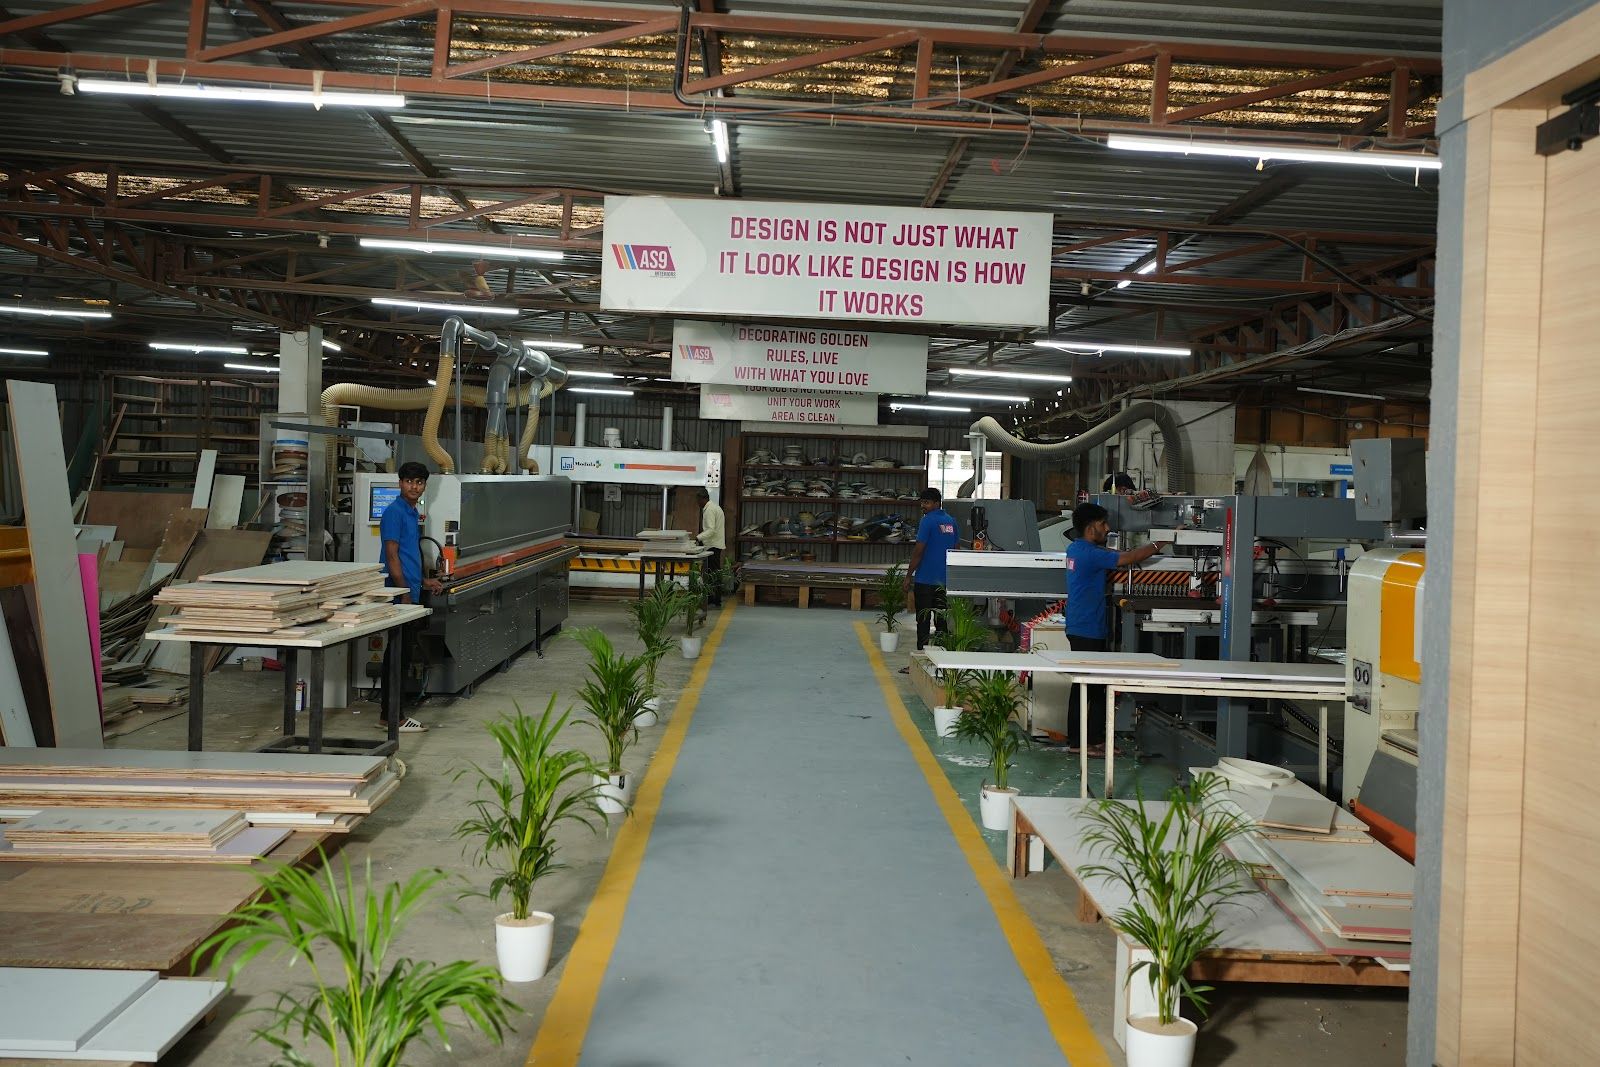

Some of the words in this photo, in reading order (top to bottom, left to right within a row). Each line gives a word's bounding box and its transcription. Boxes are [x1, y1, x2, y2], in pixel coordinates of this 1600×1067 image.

[731, 217, 809, 241] DESIGN
[817, 220, 837, 242] IS
[845, 221, 886, 244] NOT
[892, 225, 948, 247] JUST
[955, 226, 1018, 249] WHAT
[639, 249, 668, 269] AS9
[719, 252, 739, 274] IT
[745, 253, 800, 276] LOOK
[809, 255, 853, 277] LIKE
[862, 257, 939, 281] DESIGN
[947, 261, 967, 283] IS
[975, 262, 1025, 284] HOW
[818, 290, 838, 312] IT
[844, 291, 922, 316] WORKS
[739, 328, 815, 344] DECORATING
[821, 331, 868, 347] GOLDEN
[767, 349, 808, 364] RULES,
[813, 352, 838, 364] LIVE
[735, 367, 765, 380] WITH
[771, 369, 806, 382] WHAT
[811, 371, 834, 383] YOU
[839, 372, 868, 385] LOVE
[767, 397, 787, 407] UNIT
[789, 398, 812, 408] YOUR
[815, 400, 841, 409] WORK
[772, 412, 794, 421] AREA
[797, 413, 805, 422] IS
[807, 413, 835, 423] CLEAN
